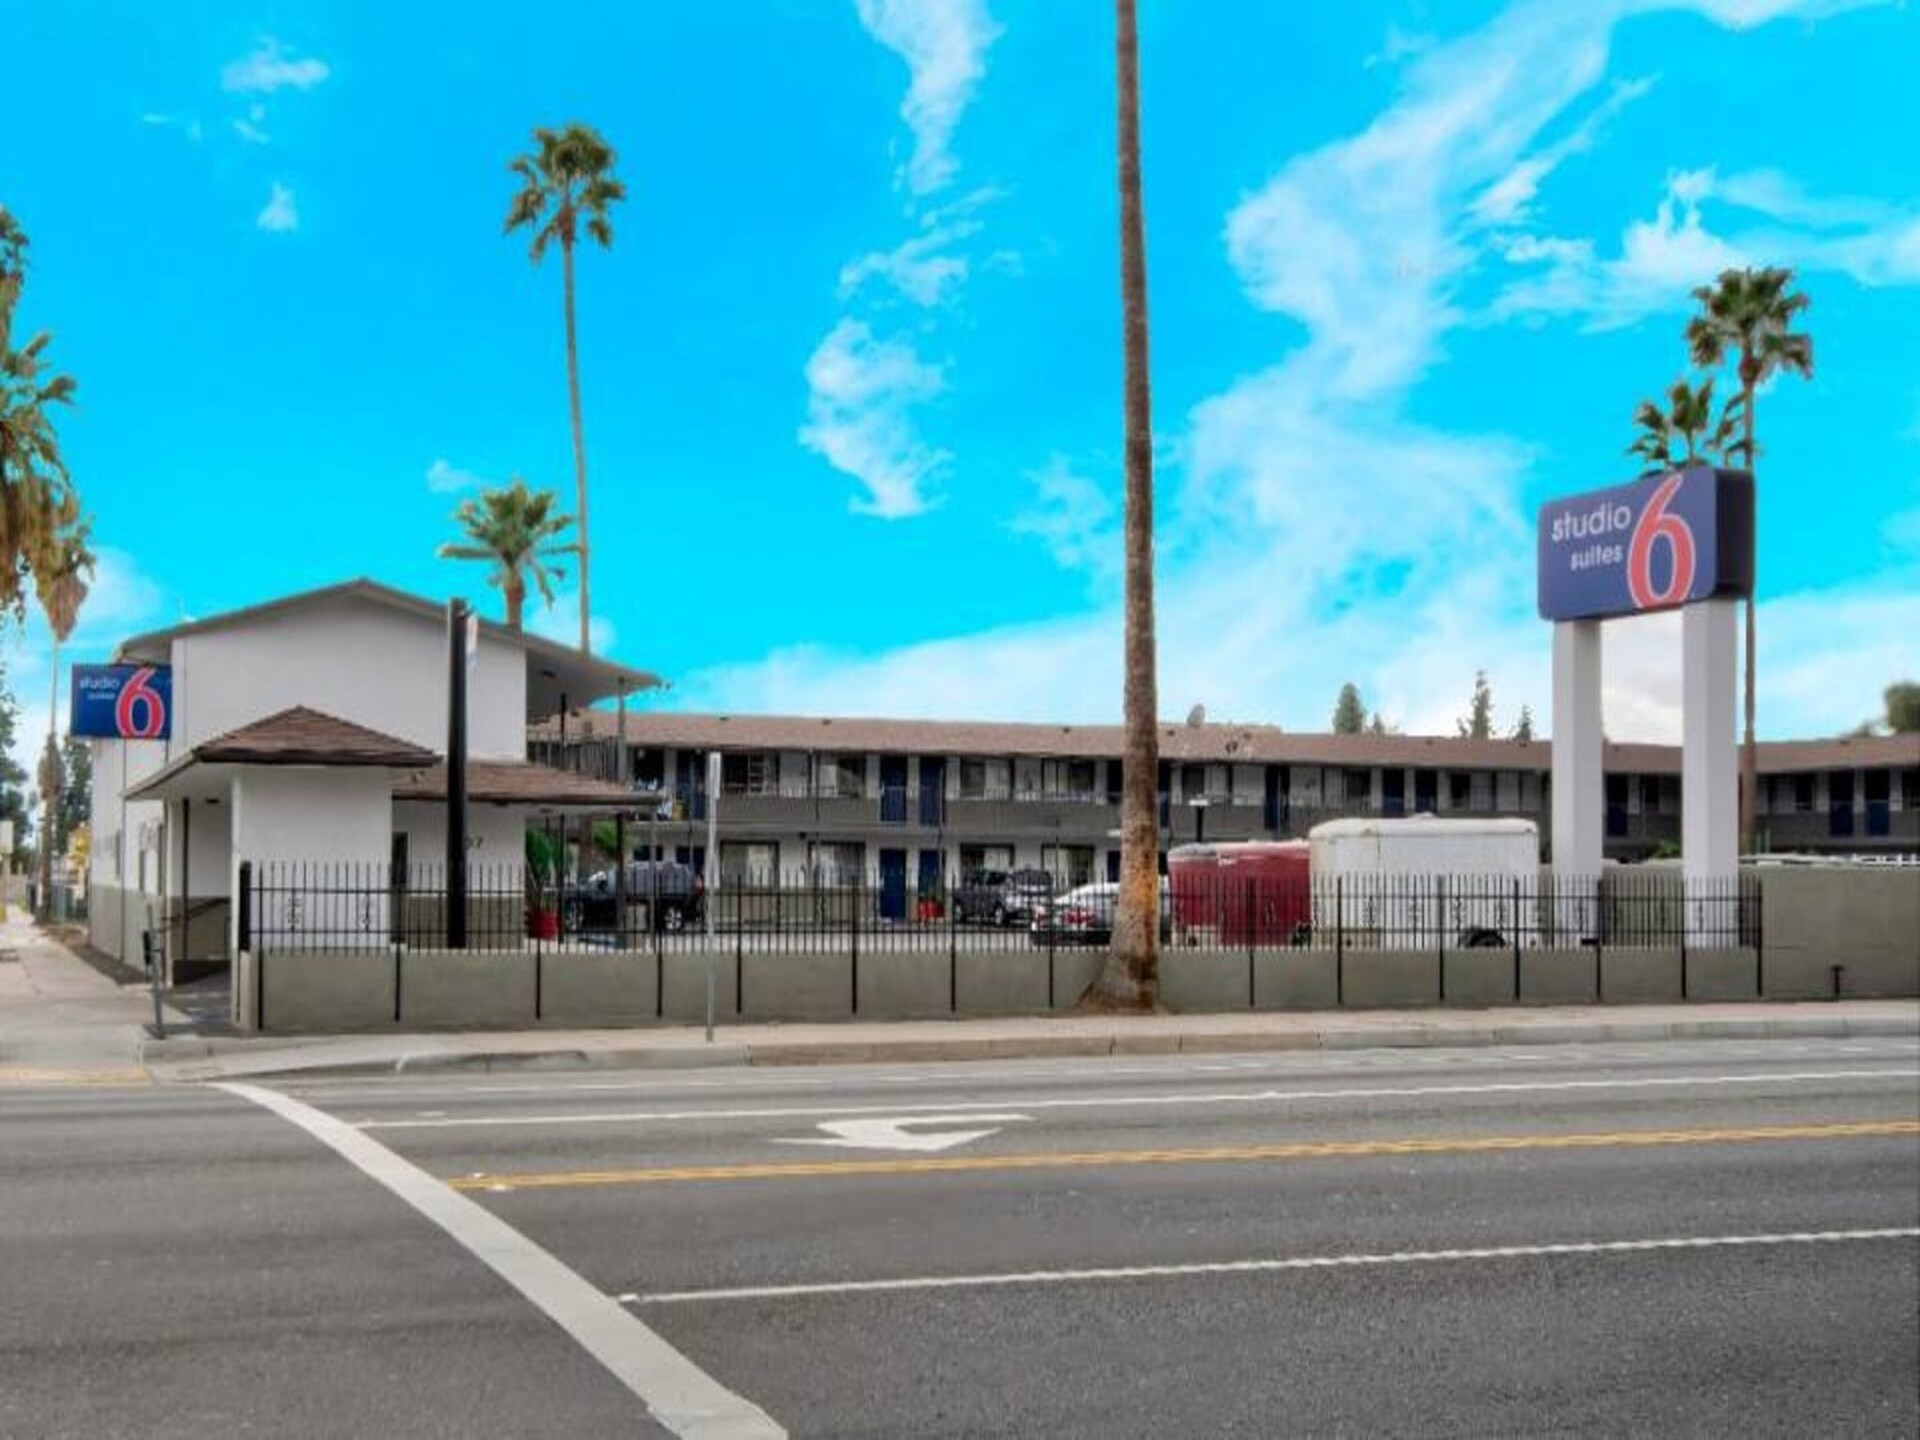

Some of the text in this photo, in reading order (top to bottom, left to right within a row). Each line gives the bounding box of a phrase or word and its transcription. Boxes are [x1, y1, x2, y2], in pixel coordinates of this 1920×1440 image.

[1552, 503, 1631, 541] studio
[1628, 473, 1696, 607] 6
[1570, 544, 1623, 570] suites
[116, 667, 165, 739] 6
